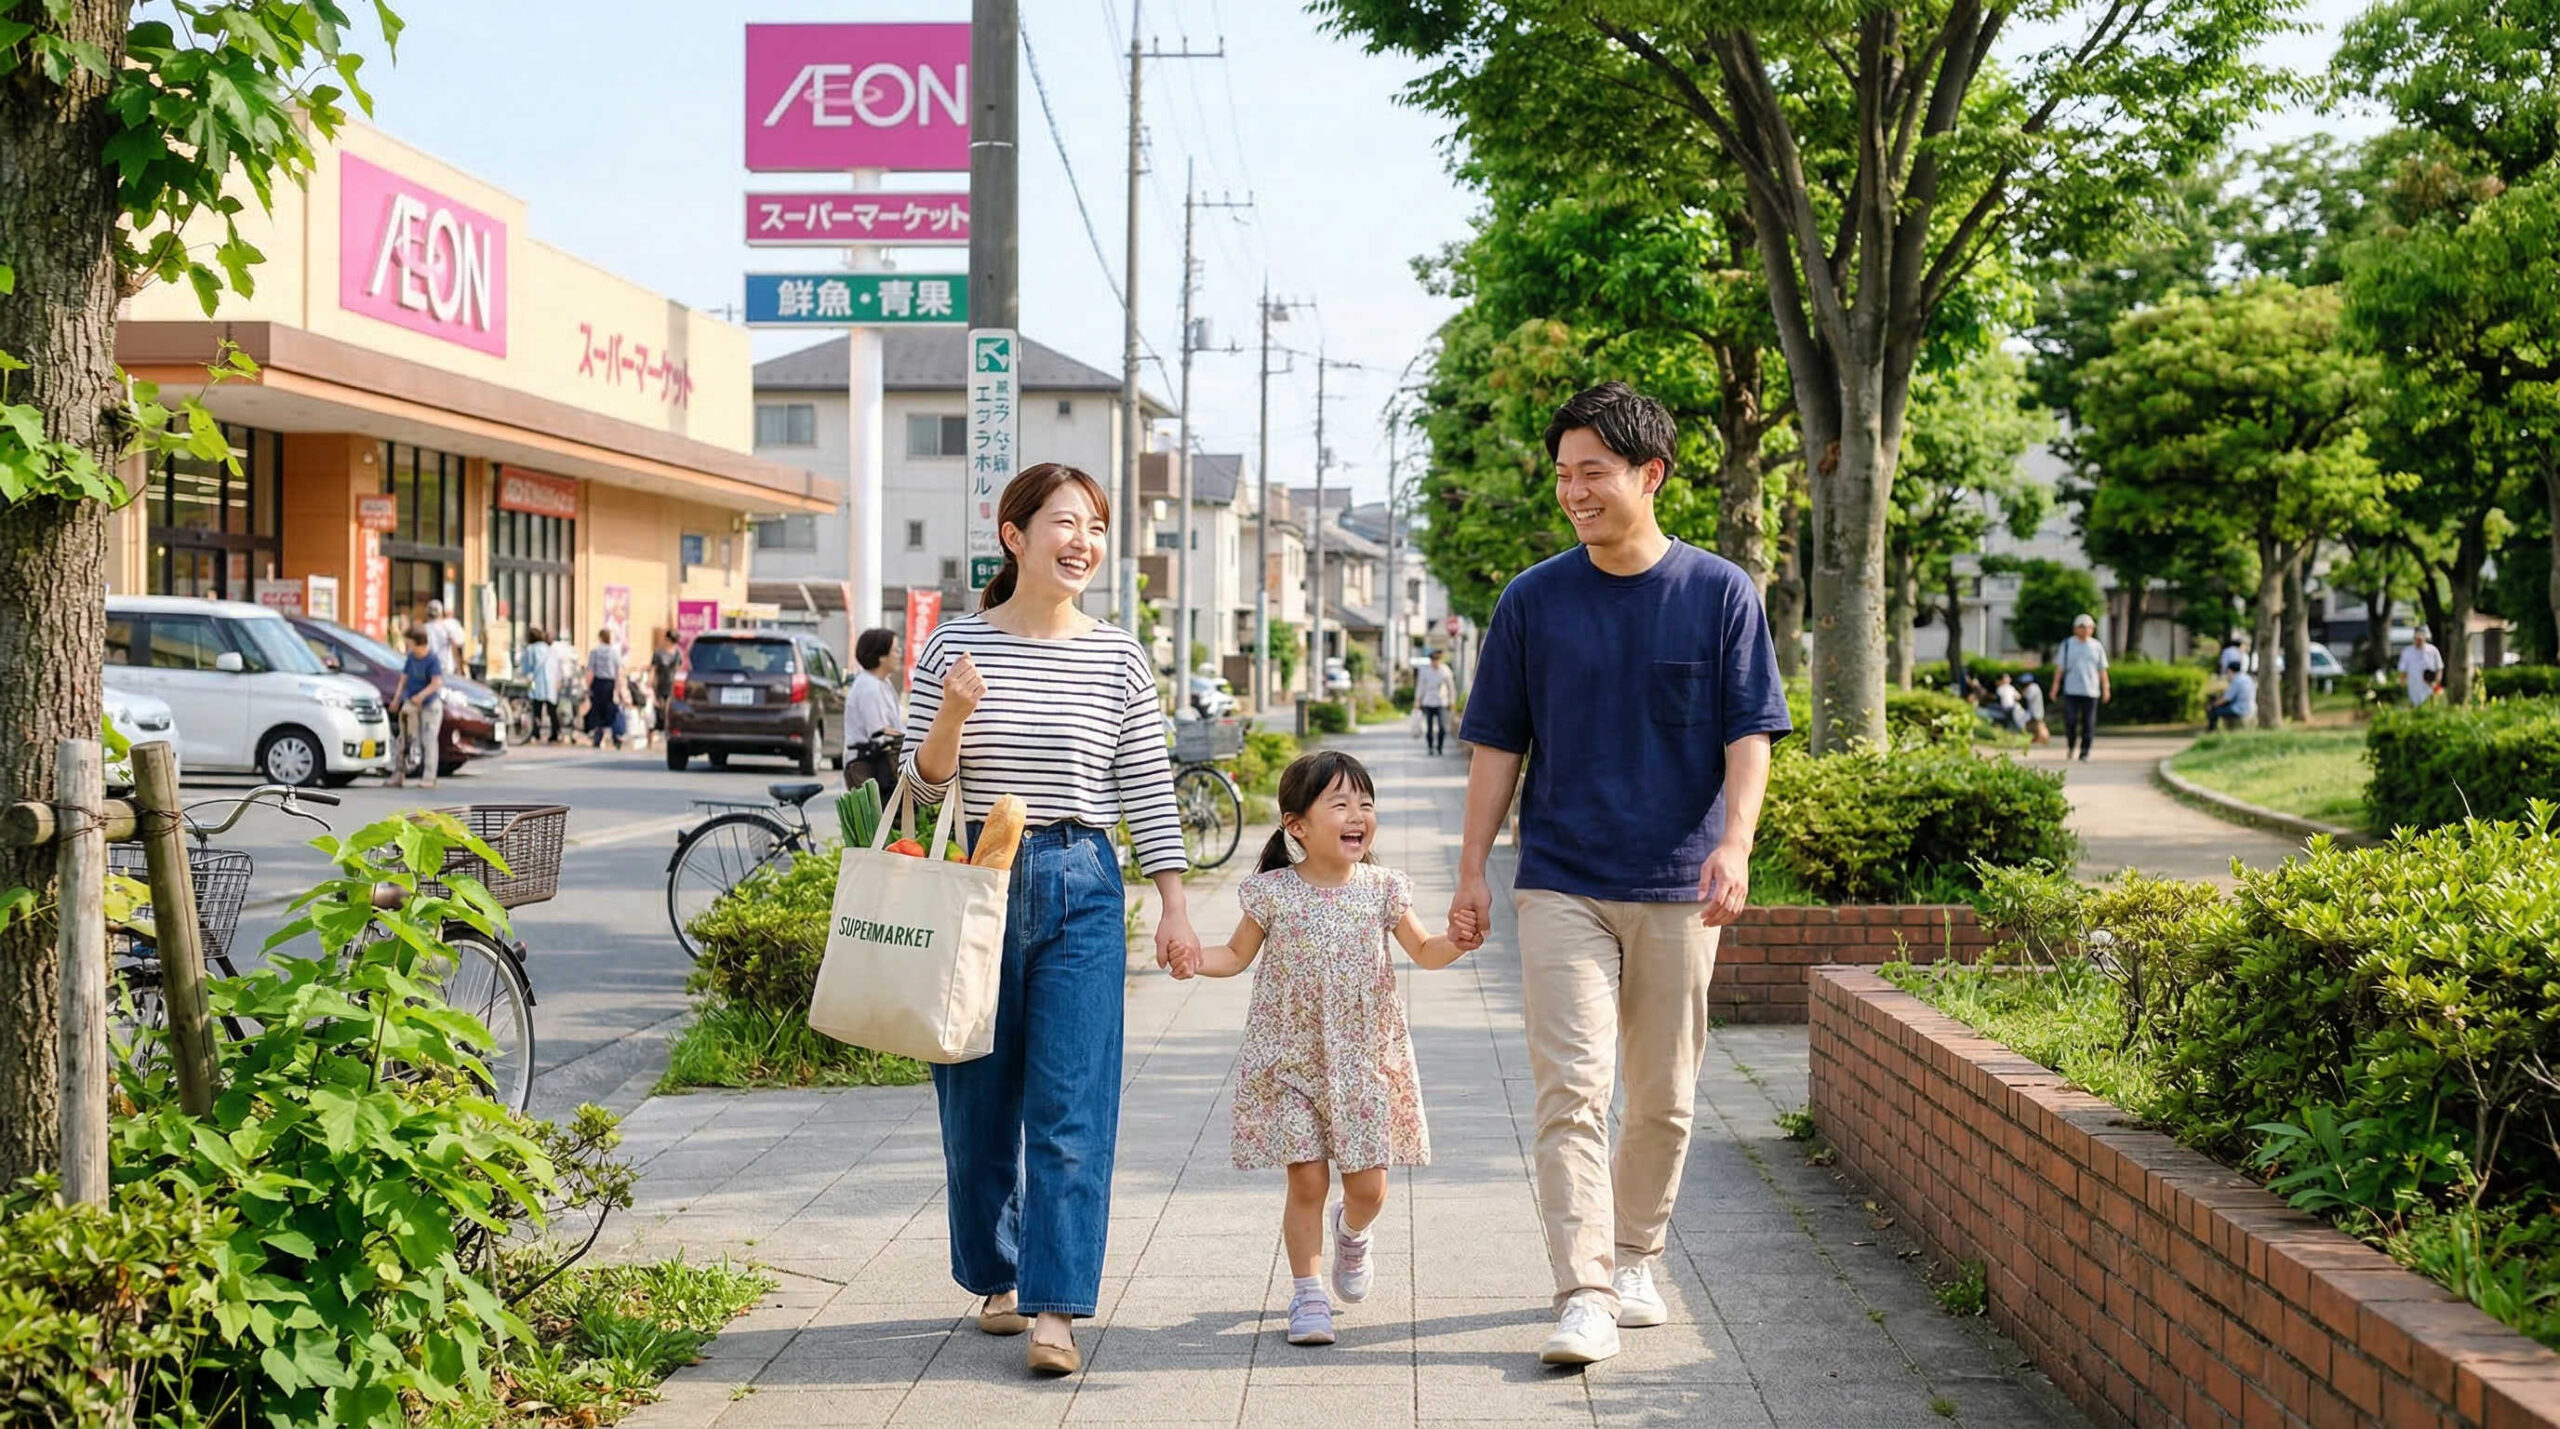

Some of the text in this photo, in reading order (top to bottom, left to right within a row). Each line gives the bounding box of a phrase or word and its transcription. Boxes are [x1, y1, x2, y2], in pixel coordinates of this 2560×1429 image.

[760, 201, 970, 231] スーパーマーケット
[777, 279, 953, 317] 鮮魚・青果
[579, 322, 693, 410] スーパーマーケット
